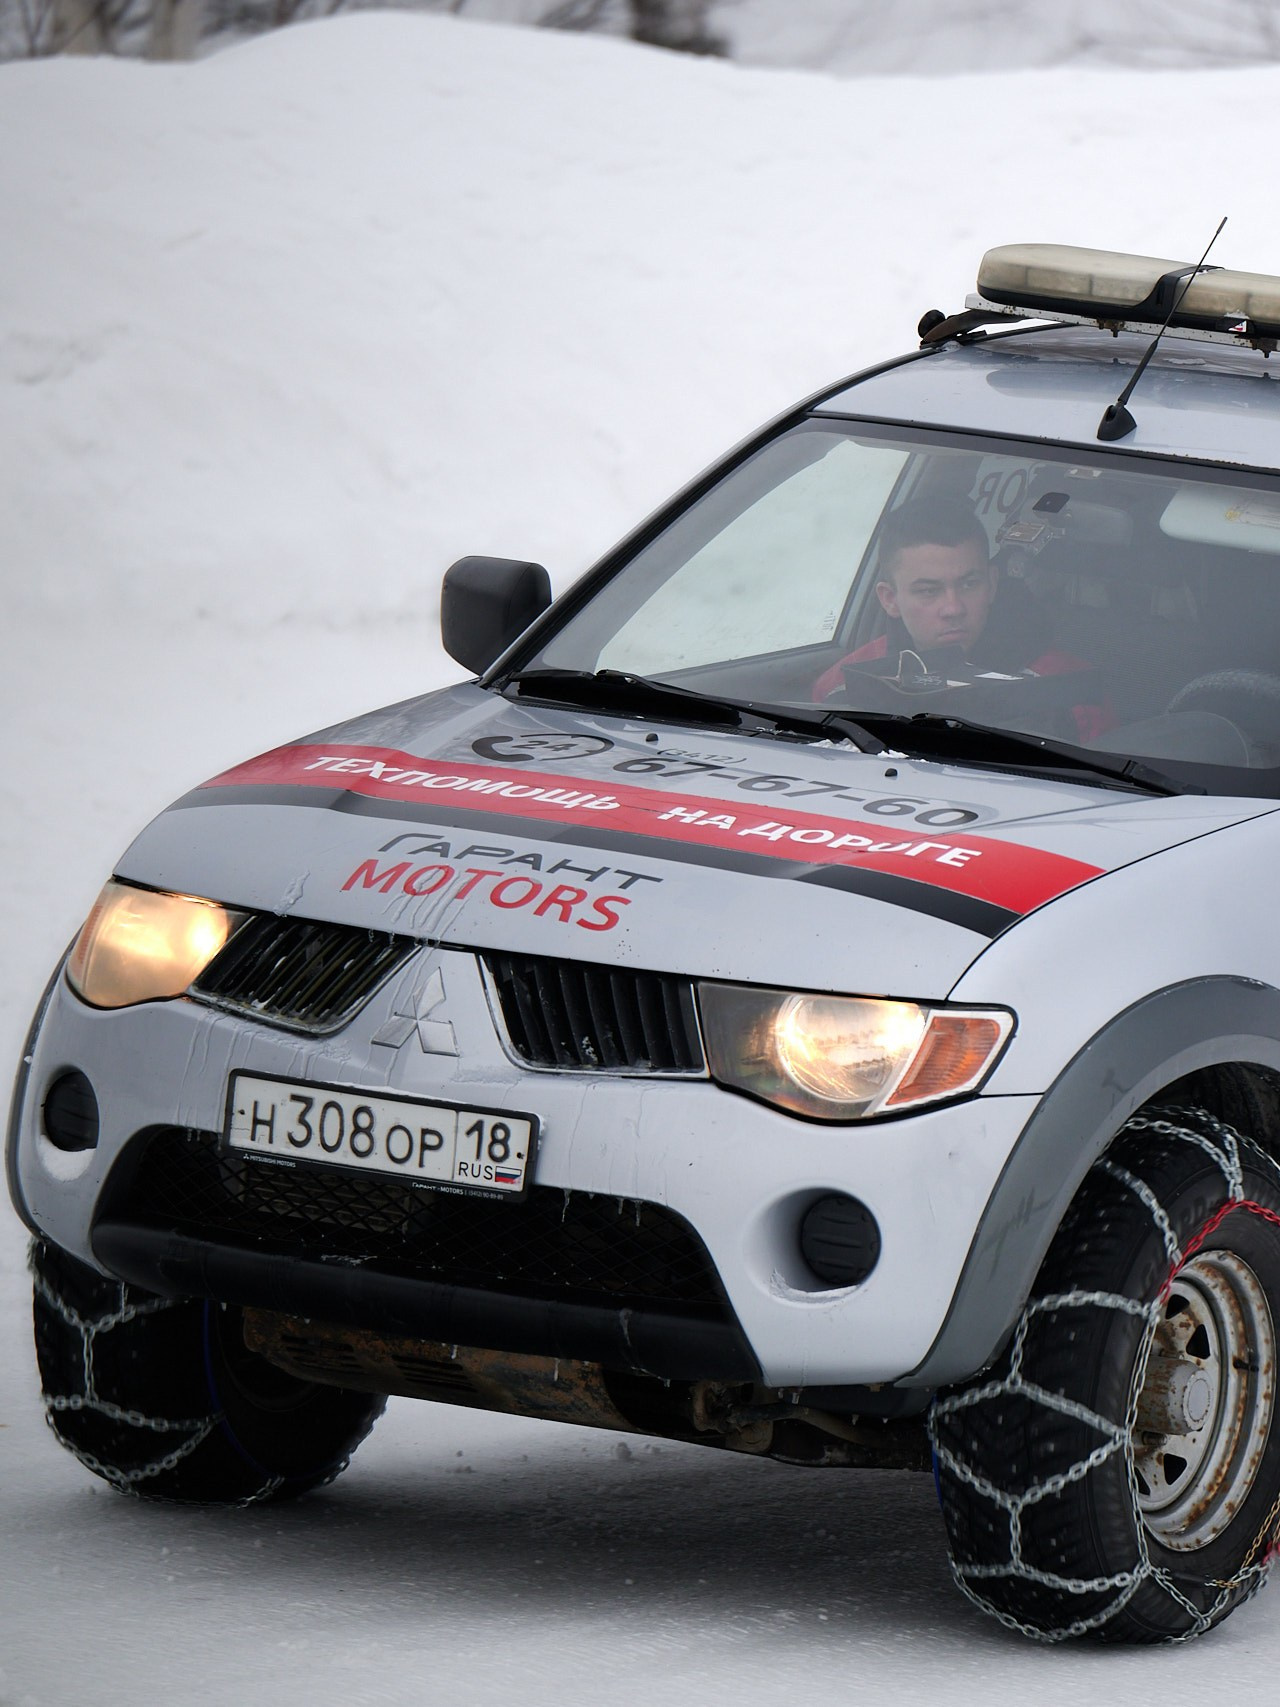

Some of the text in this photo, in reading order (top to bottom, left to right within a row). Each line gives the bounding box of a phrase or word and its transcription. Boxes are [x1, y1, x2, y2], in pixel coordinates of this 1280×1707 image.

[512, 741, 579, 751] 24
[657, 748, 747, 766] (3412)
[304, 757, 982, 867] ТЕХПОМОЩЬ НА ДОРОГЕ
[613, 758, 979, 826] 67-67-60
[377, 833, 664, 889] ГАРАНТ
[342, 859, 632, 931] MOTORS
[465, 1119, 510, 1162] 18
[458, 1161, 493, 1181] RUS
